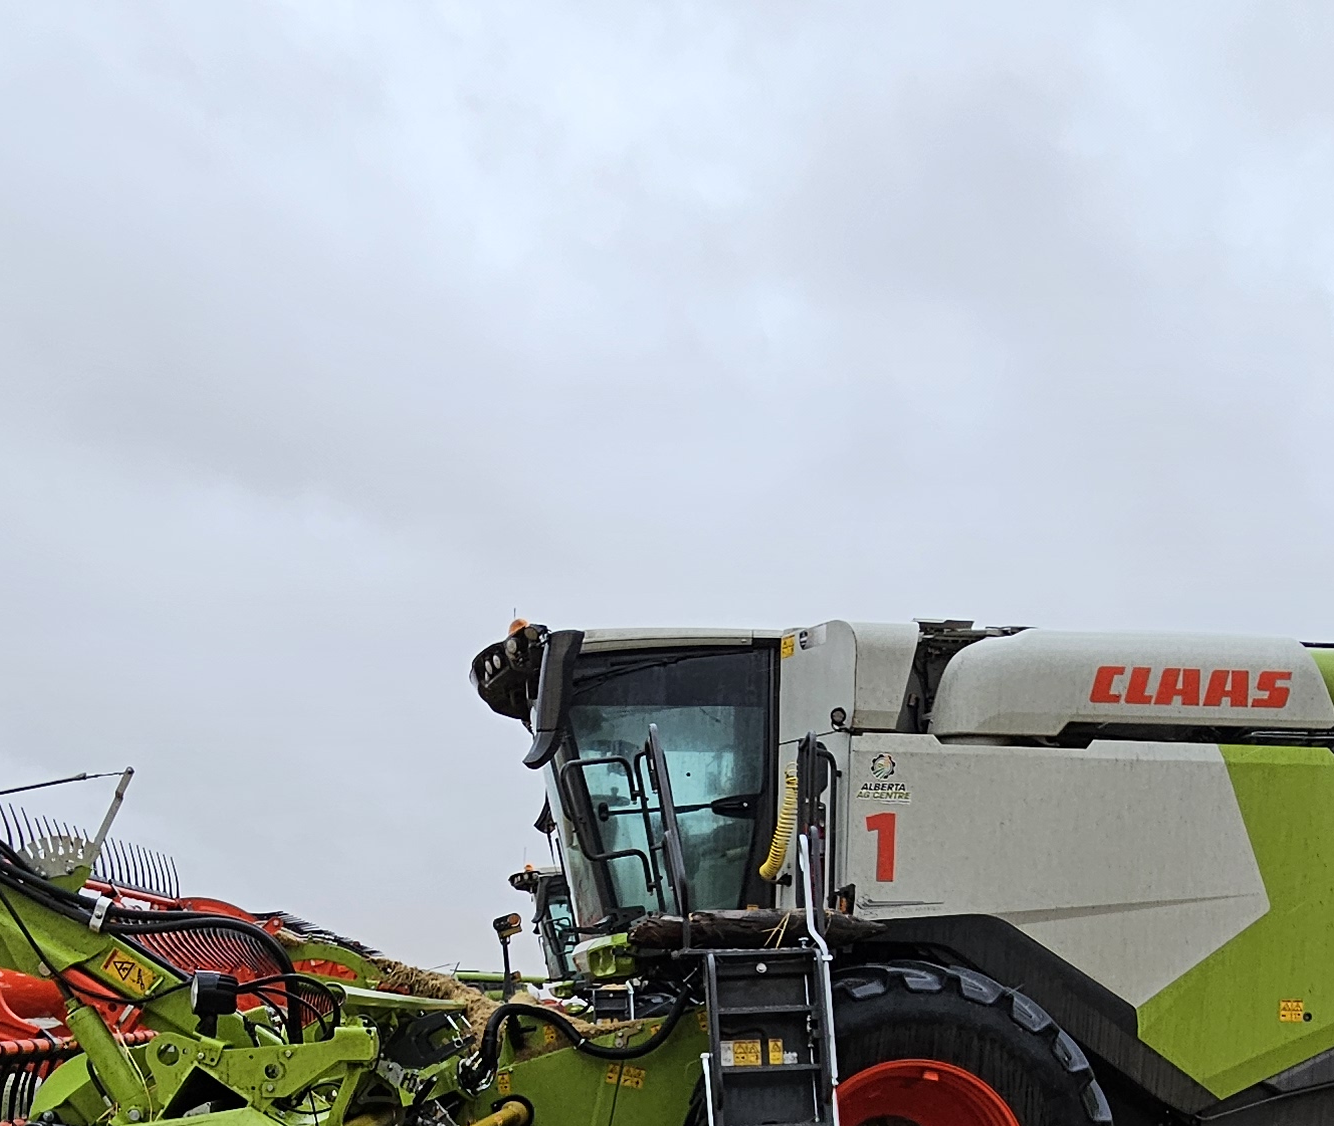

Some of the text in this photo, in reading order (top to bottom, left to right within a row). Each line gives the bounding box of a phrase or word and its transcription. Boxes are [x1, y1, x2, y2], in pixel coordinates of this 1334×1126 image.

[1089, 666, 1293, 709] CLAAS
[856, 791, 910, 800] AG CENTRE
[861, 783, 906, 791] ALBERTA
[865, 812, 896, 882] 1
